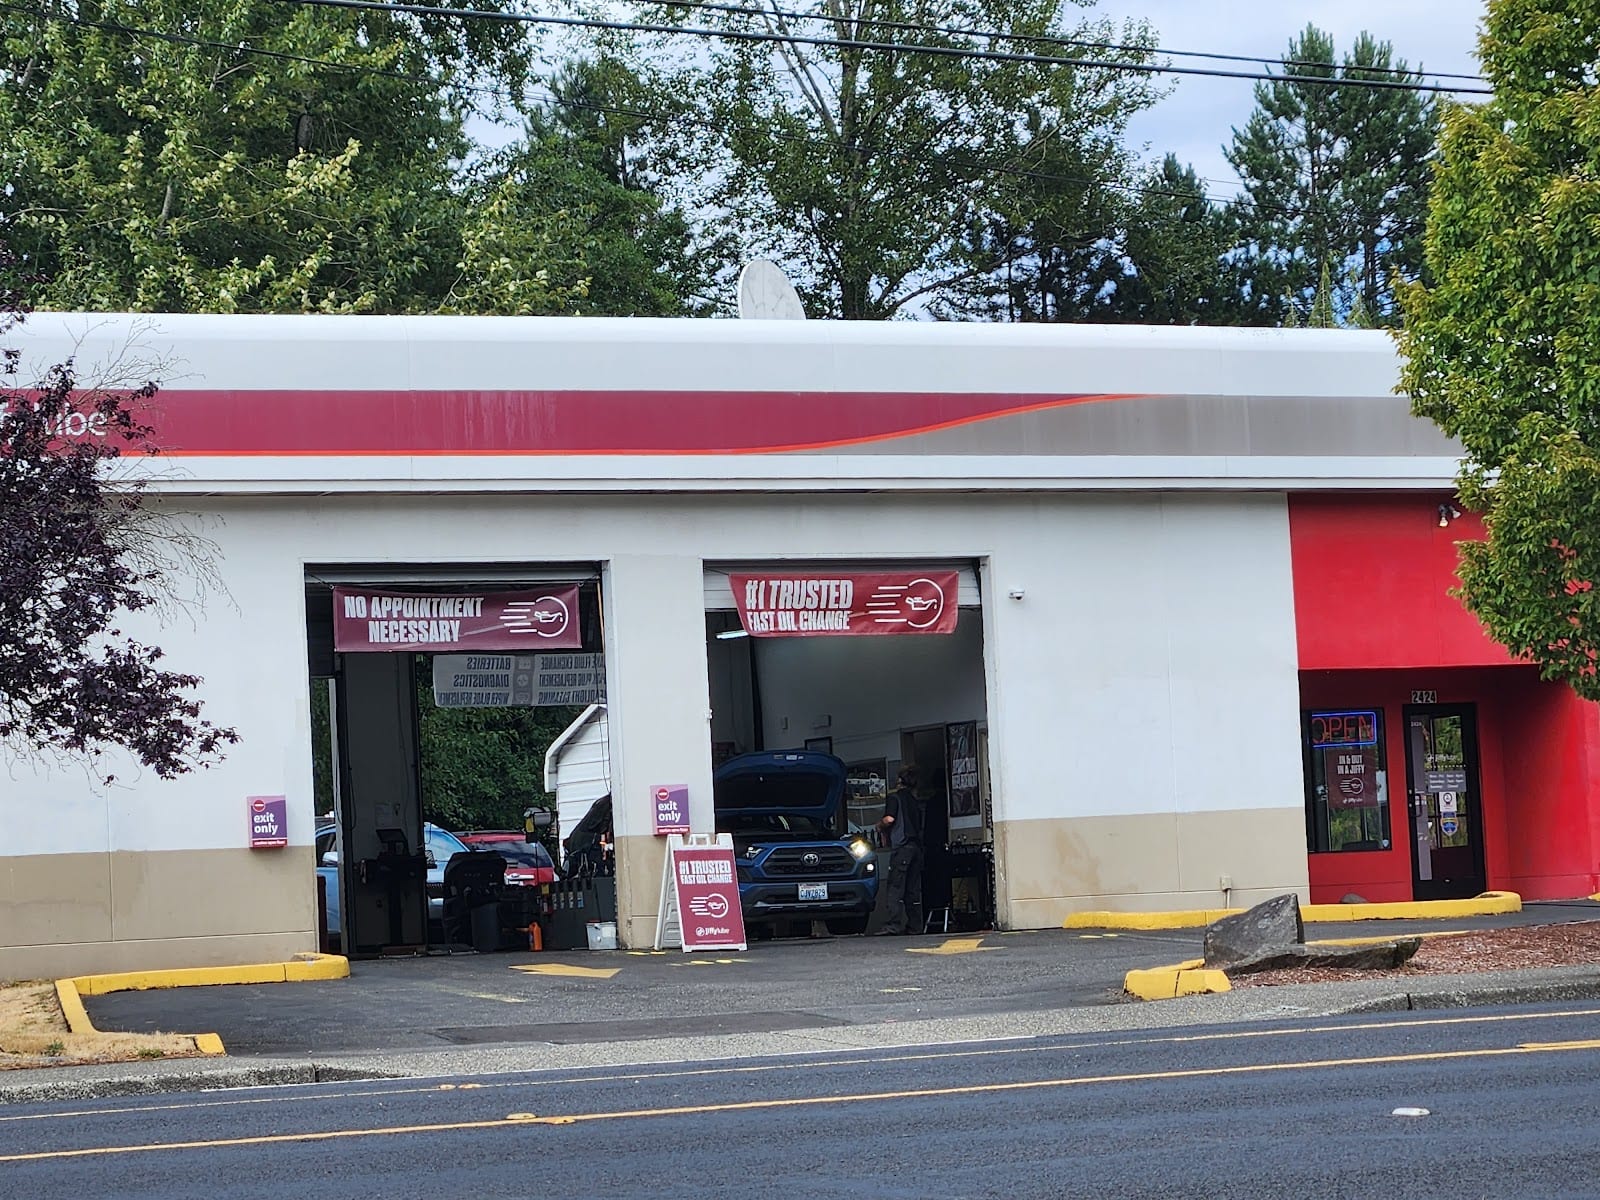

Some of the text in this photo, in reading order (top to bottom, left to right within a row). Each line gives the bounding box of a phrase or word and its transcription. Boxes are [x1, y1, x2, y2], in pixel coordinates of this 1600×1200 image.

[746, 579, 854, 609] #1 TRUSTED
[344, 596, 484, 618] NO APPOINTMENT
[747, 611, 850, 631] FAST OIL CHANGE
[368, 620, 461, 643] NECESSARY
[1412, 691, 1436, 703] 2424
[1312, 715, 1374, 744] OPEN
[1346, 755, 1351, 764] &
[1345, 765, 1349, 774] A
[1350, 764, 1365, 774] JIFFY
[658, 801, 678, 811] exit
[253, 812, 275, 823] exit
[658, 811, 681, 823] only
[254, 823, 279, 836] only
[690, 860, 732, 874] TRUSTED
[680, 874, 696, 885] FAST
[707, 874, 733, 884] CHANGE
